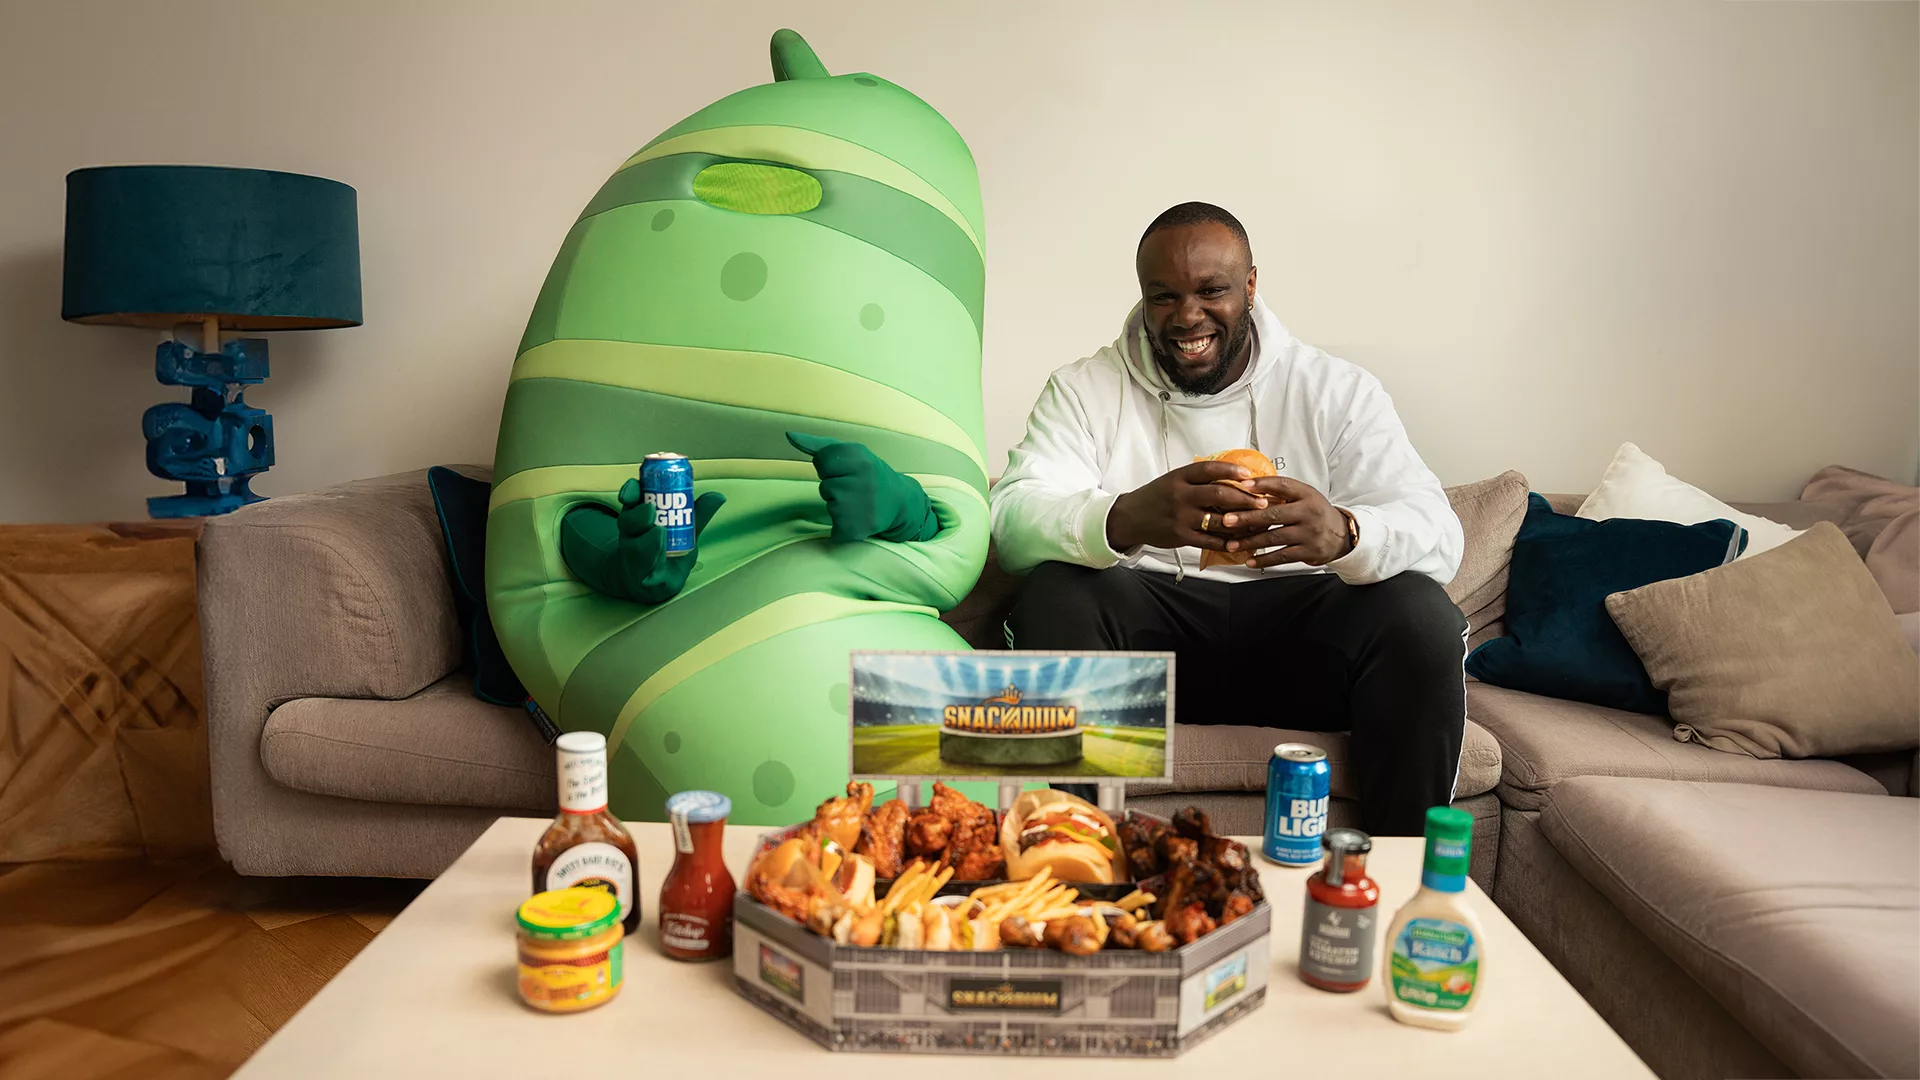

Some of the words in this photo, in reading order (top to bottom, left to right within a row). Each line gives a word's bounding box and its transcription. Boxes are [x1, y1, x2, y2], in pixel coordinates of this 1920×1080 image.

[644, 493, 687, 510] BUD
[654, 508, 693, 527] GHT
[1411, 940, 1463, 962] Ranch
